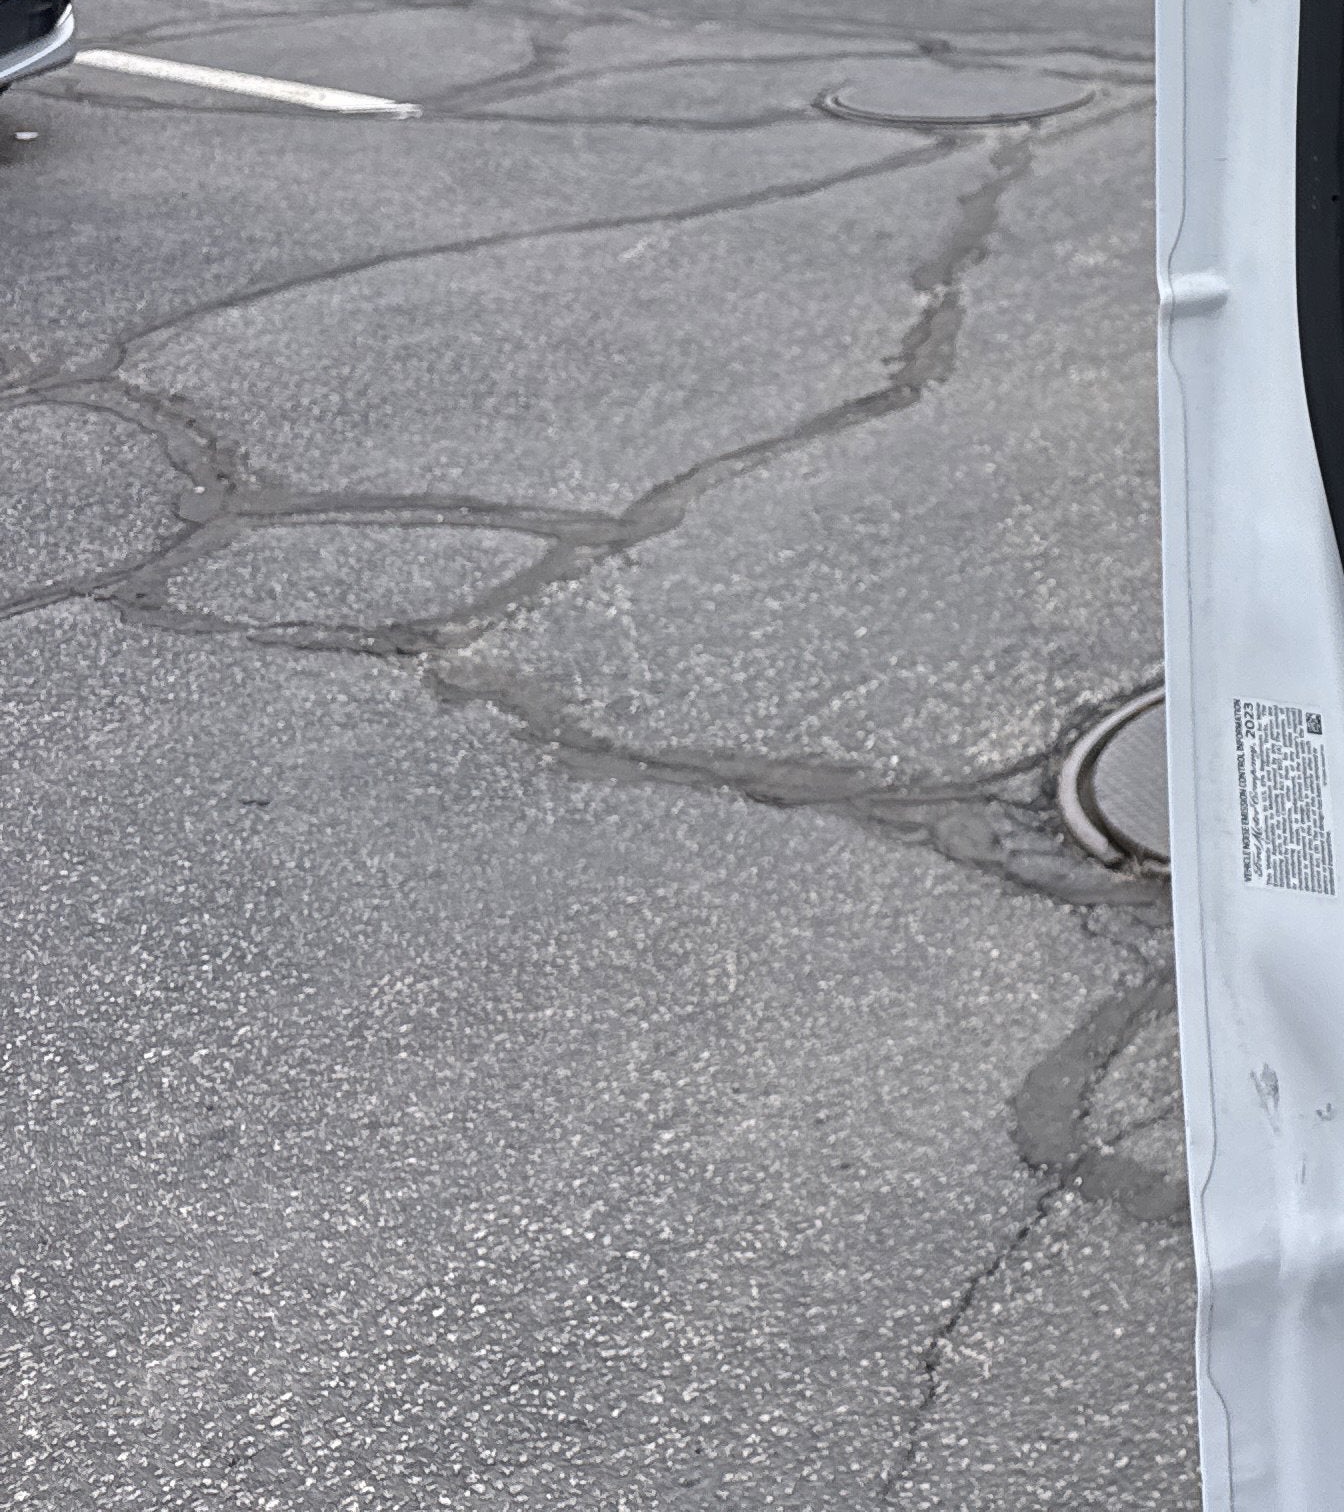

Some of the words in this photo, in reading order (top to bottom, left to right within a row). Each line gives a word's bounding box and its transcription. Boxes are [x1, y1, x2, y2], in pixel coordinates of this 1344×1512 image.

[1233, 699, 1244, 751] INFORMATION
[1244, 702, 1254, 739] 2023
[1237, 754, 1246, 787] CONTROL
[1239, 789, 1248, 825] EMISSION
[1241, 826, 1249, 848] NOISE
[1243, 849, 1251, 882] VEHICLE
